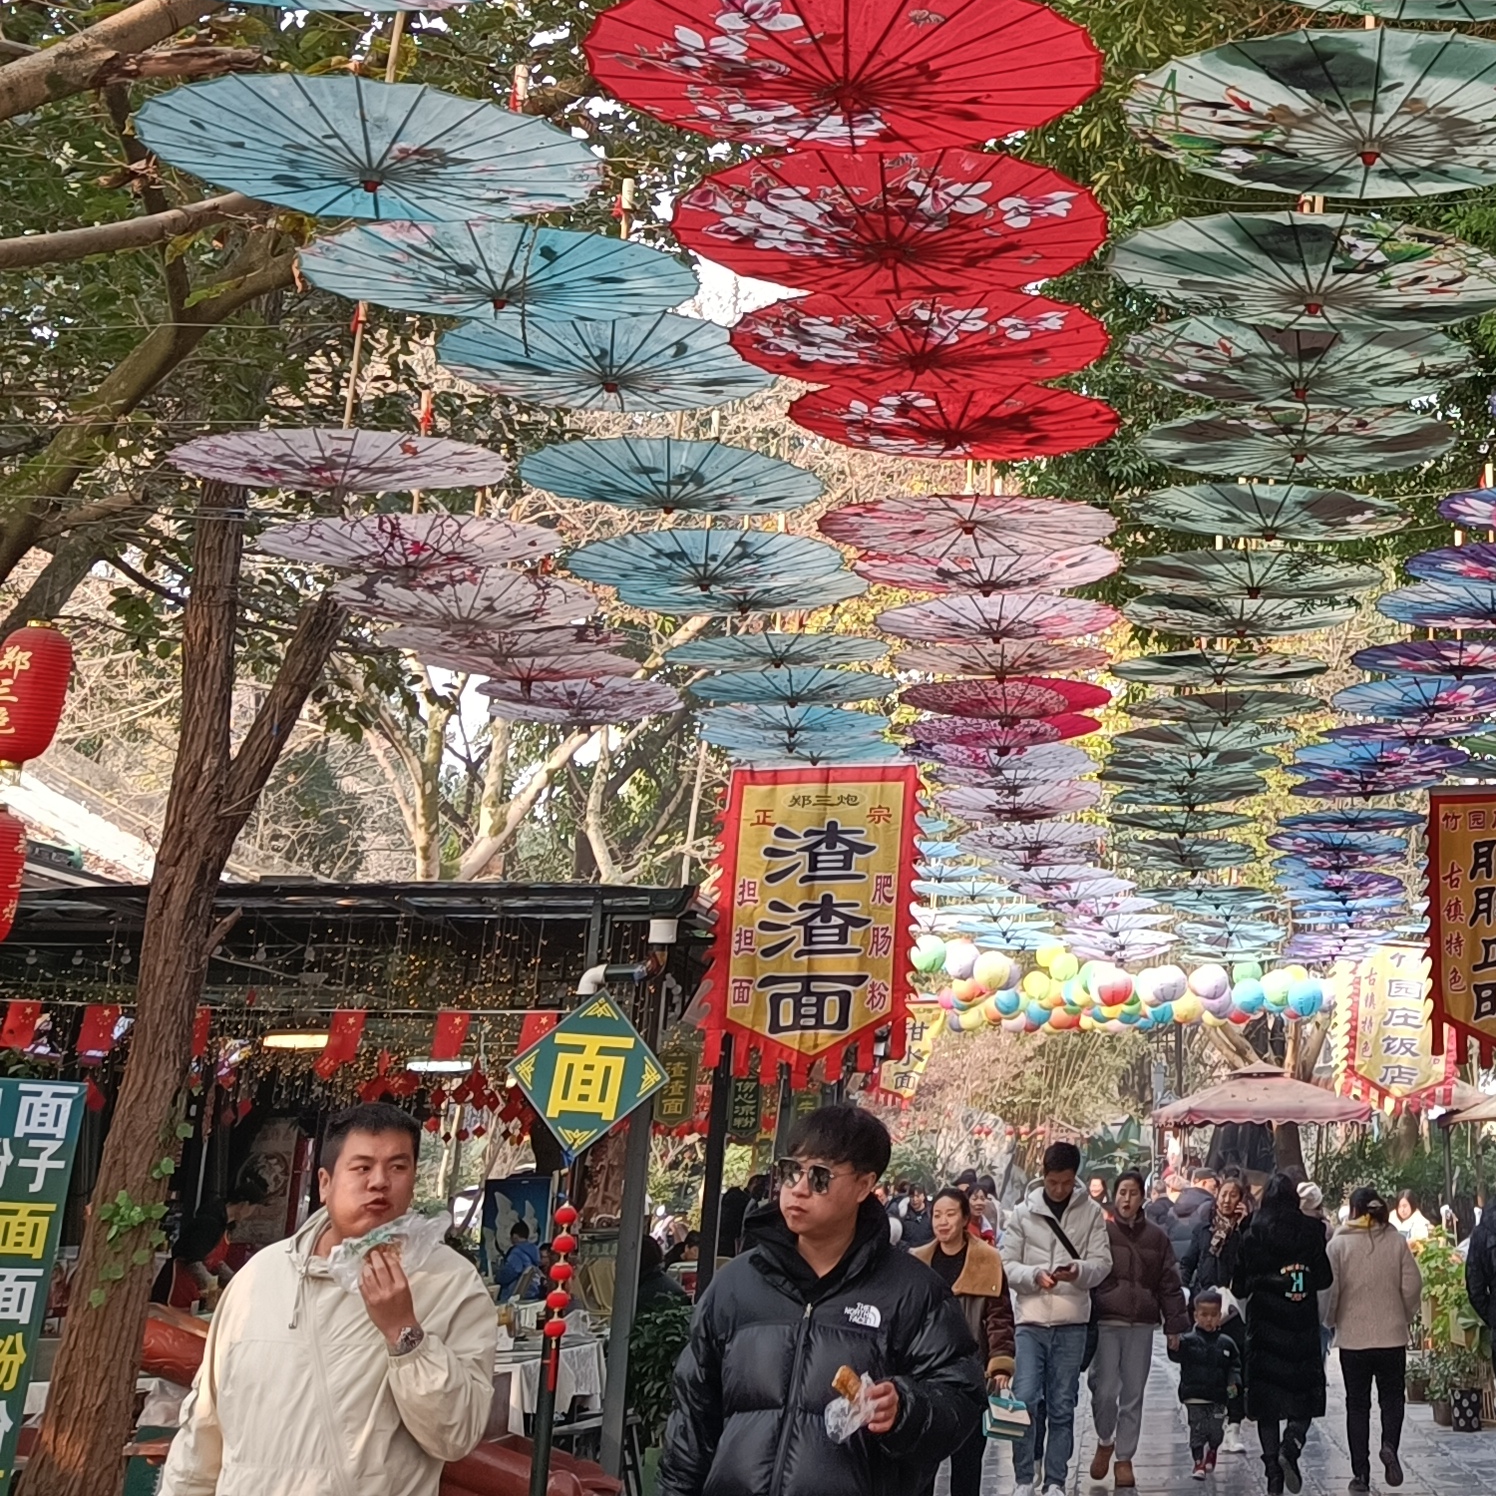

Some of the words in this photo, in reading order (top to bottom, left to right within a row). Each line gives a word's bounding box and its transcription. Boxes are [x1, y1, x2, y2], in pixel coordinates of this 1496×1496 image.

[731, 878, 759, 1006] 担担面
[756, 820, 877, 1036] 渣渣面
[866, 874, 895, 1014] 肥肠粉
[1441, 861, 1468, 995] 古镇特色
[0, 1083, 80, 1140] 面
[545, 1030, 636, 1122] 面
[662, 1060, 689, 1116] 渣渣面
